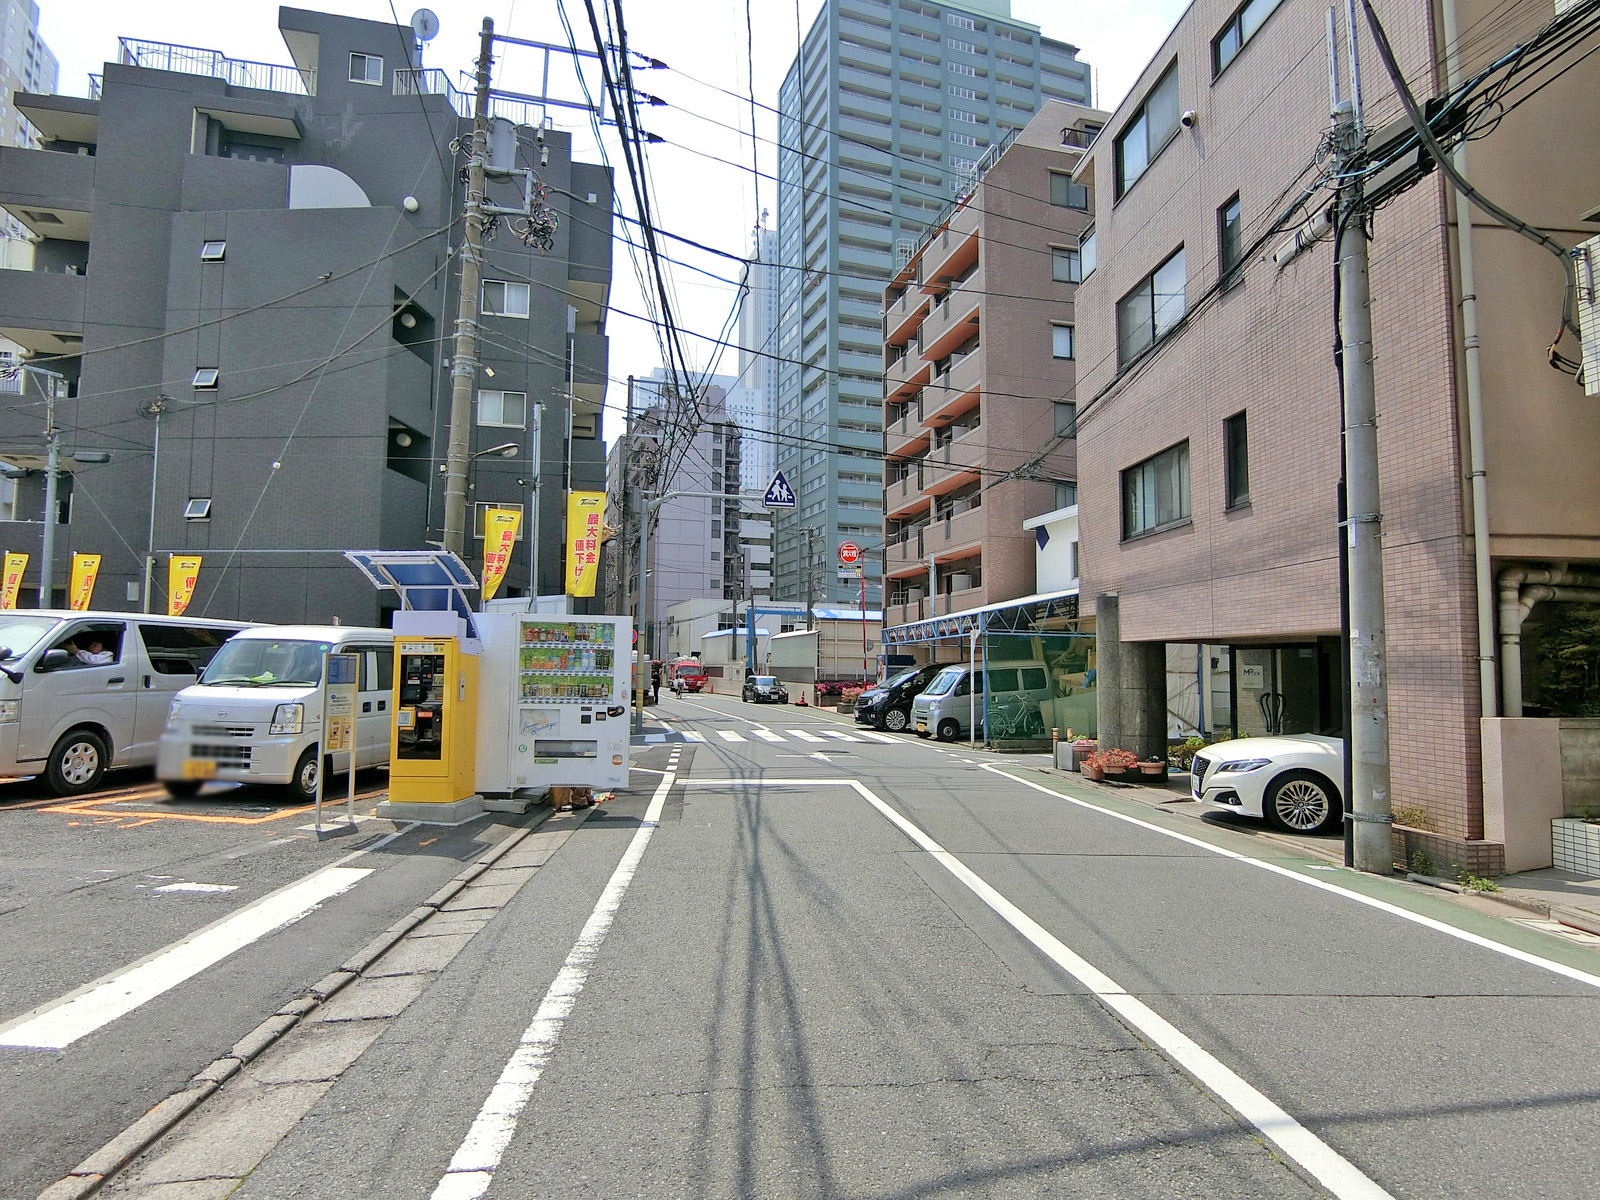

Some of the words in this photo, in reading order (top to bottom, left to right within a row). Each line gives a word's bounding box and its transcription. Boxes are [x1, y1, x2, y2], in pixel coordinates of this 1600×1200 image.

[493, 530, 513, 575] 最大料金
[586, 513, 600, 564] 最大料金
